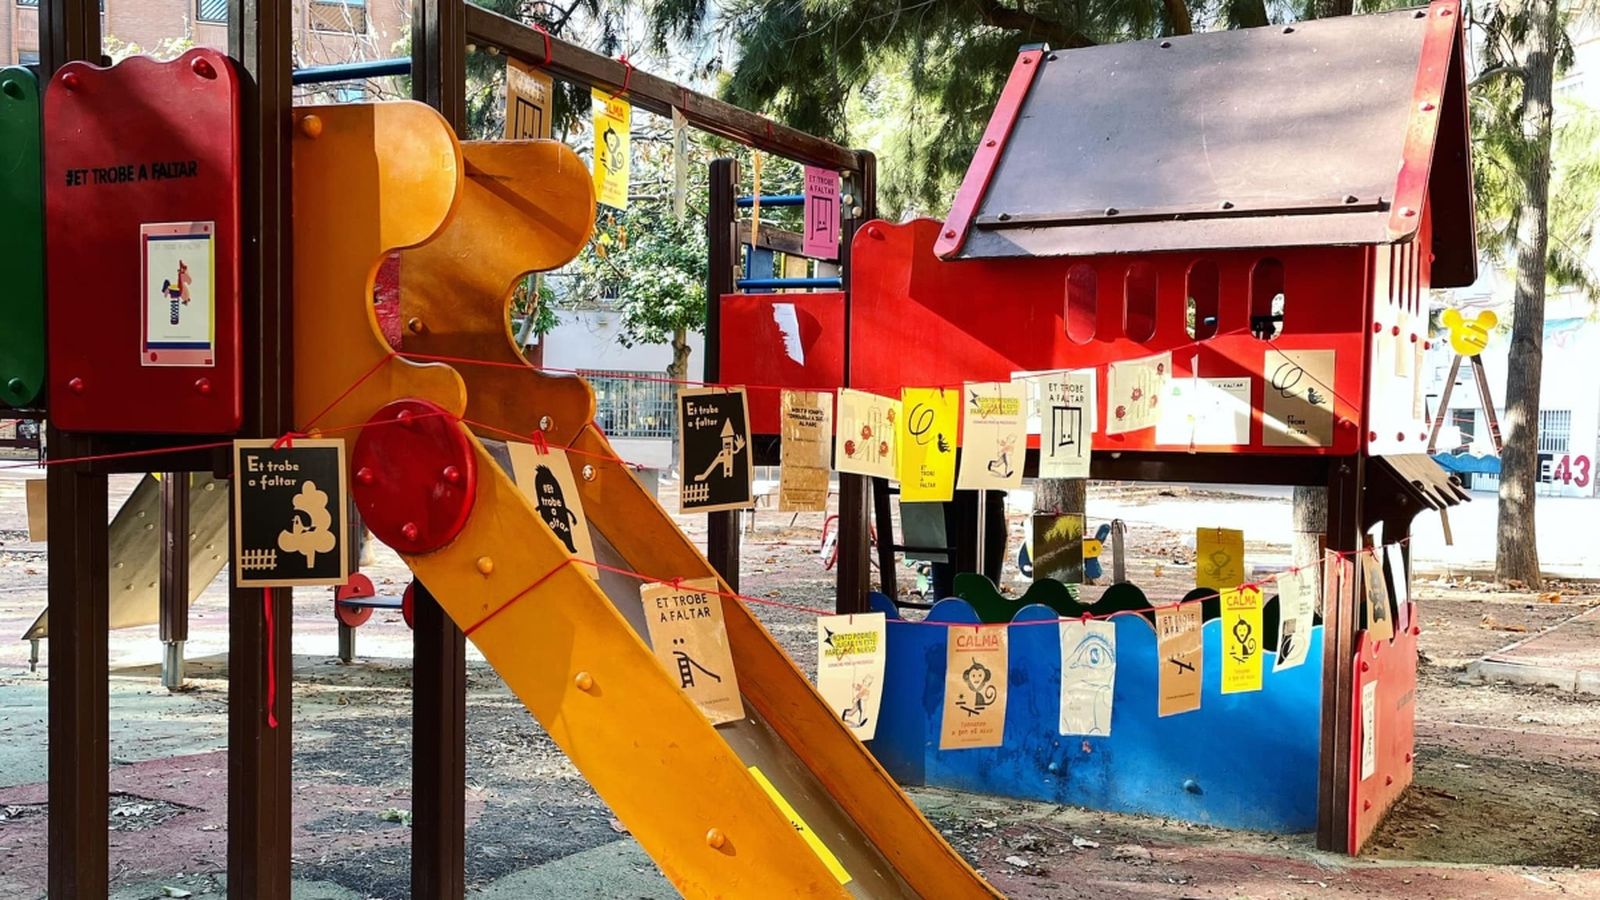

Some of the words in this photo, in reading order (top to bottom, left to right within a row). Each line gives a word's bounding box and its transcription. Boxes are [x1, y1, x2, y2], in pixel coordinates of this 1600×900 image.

[65, 168, 88, 187] #ET
[92, 164, 134, 184] TROBE
[138, 163, 148, 181] A
[151, 160, 198, 181] FALTAR
[1048, 383, 1058, 392] ET
[1049, 394, 1055, 402] A
[686, 401, 698, 416] Et
[699, 403, 719, 415] trobe
[695, 416, 718, 430] faltar
[247, 455, 265, 472] Et
[267, 459, 300, 472] trobe
[248, 479, 256, 487] a
[260, 474, 297, 490] faltar
[541, 497, 563, 507] trobe
[656, 597, 669, 609] ET
[672, 592, 708, 608] TROBE
[1226, 594, 1257, 607] CALMA
[660, 612, 668, 623] A
[670, 606, 711, 622] FALTAR
[956, 634, 999, 648] CALMA
